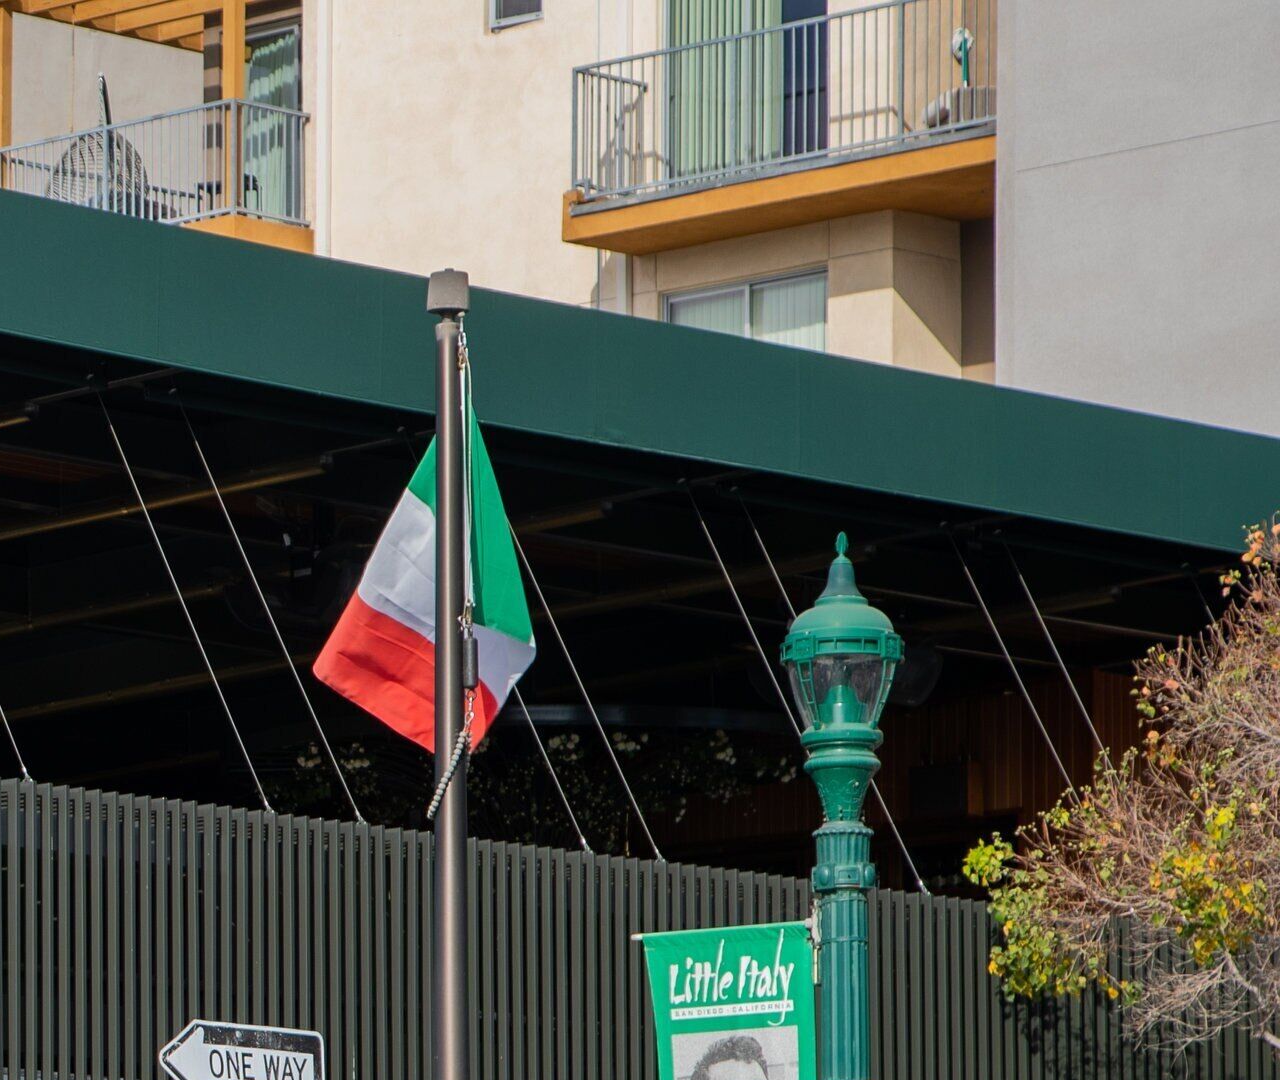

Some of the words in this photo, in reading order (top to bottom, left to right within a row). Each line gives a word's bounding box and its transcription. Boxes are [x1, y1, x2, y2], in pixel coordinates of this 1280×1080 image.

[669, 939, 734, 1005] Little
[737, 928, 795, 1026] Italy
[675, 1009, 694, 1018] SAN
[697, 1008, 724, 1017] DIEGO
[732, 1003, 792, 1014] CALIFORNIA
